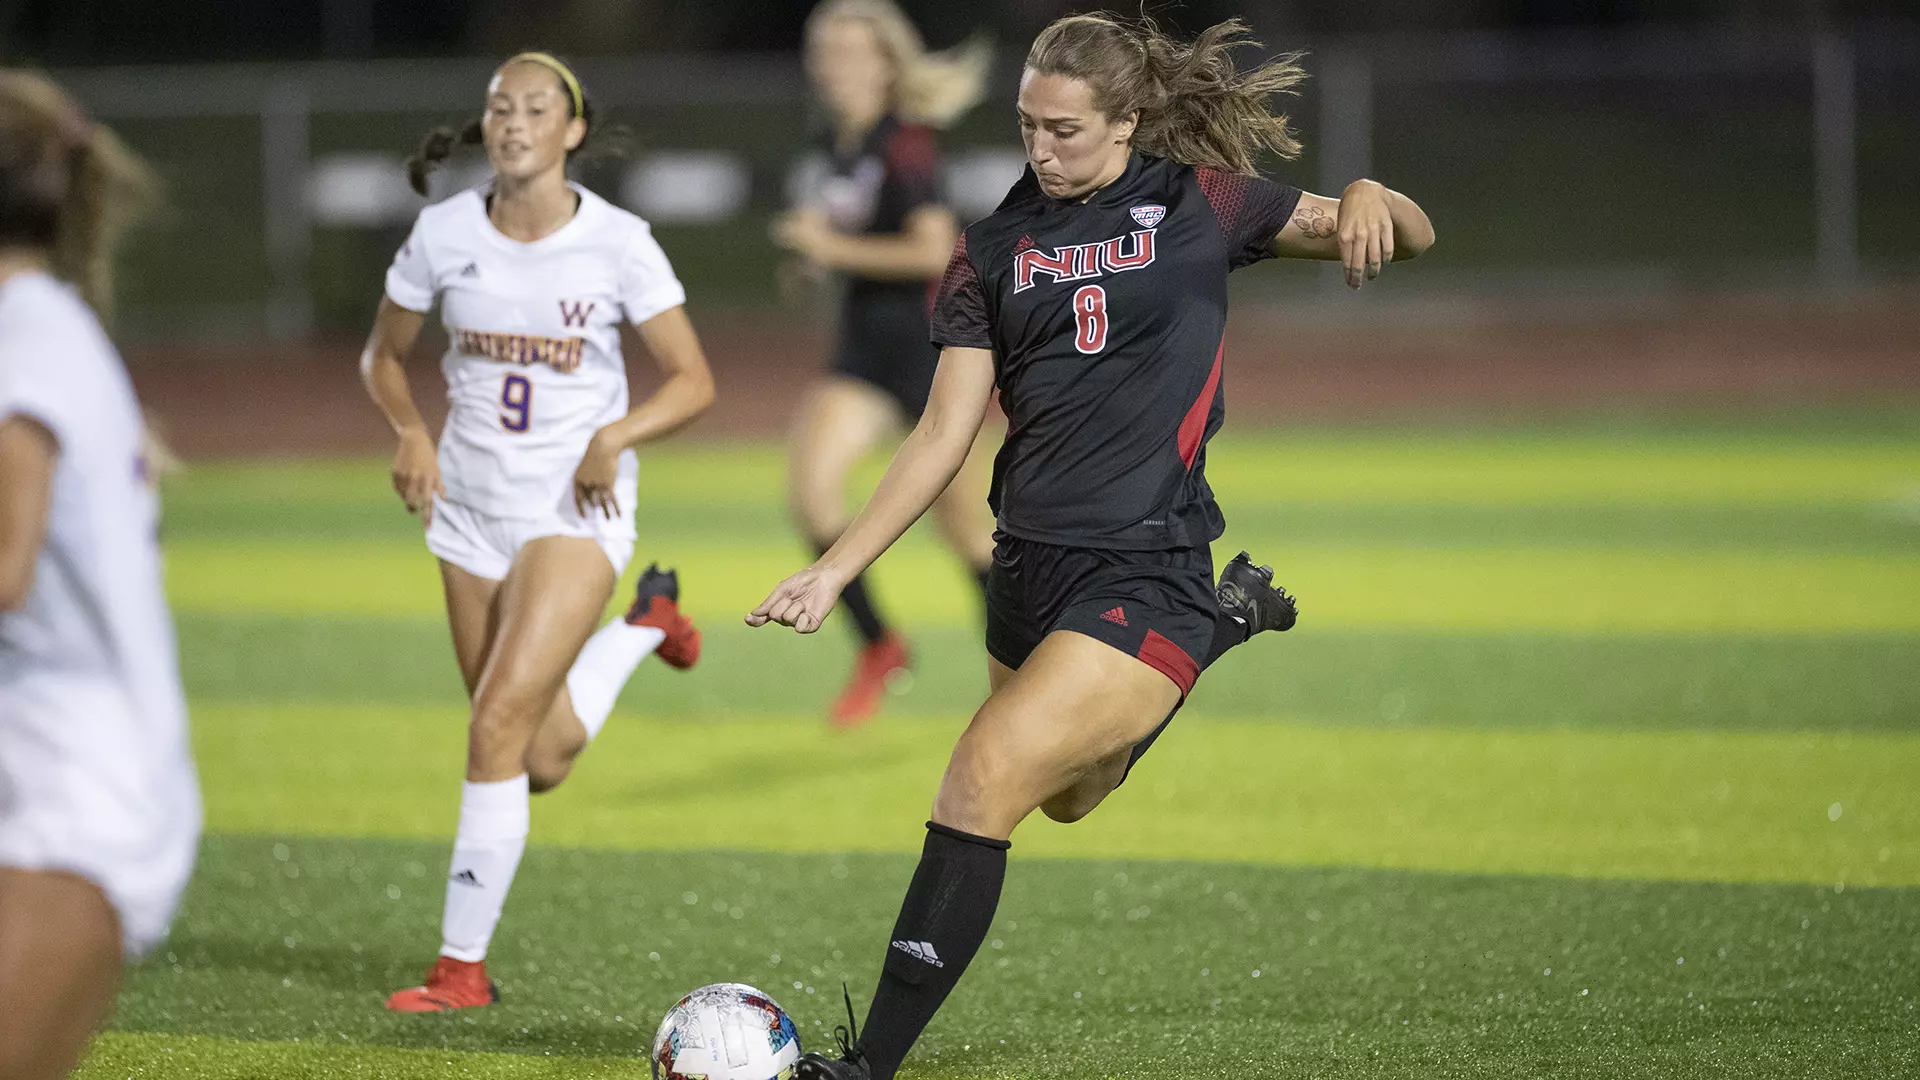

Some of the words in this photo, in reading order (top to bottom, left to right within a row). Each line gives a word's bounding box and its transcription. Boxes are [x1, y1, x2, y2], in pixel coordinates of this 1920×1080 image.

[1014, 228, 1157, 294] NIU
[559, 299, 595, 327] W
[1073, 284, 1108, 354] 8
[501, 372, 533, 433] 9
[892, 941, 944, 967] adidas
